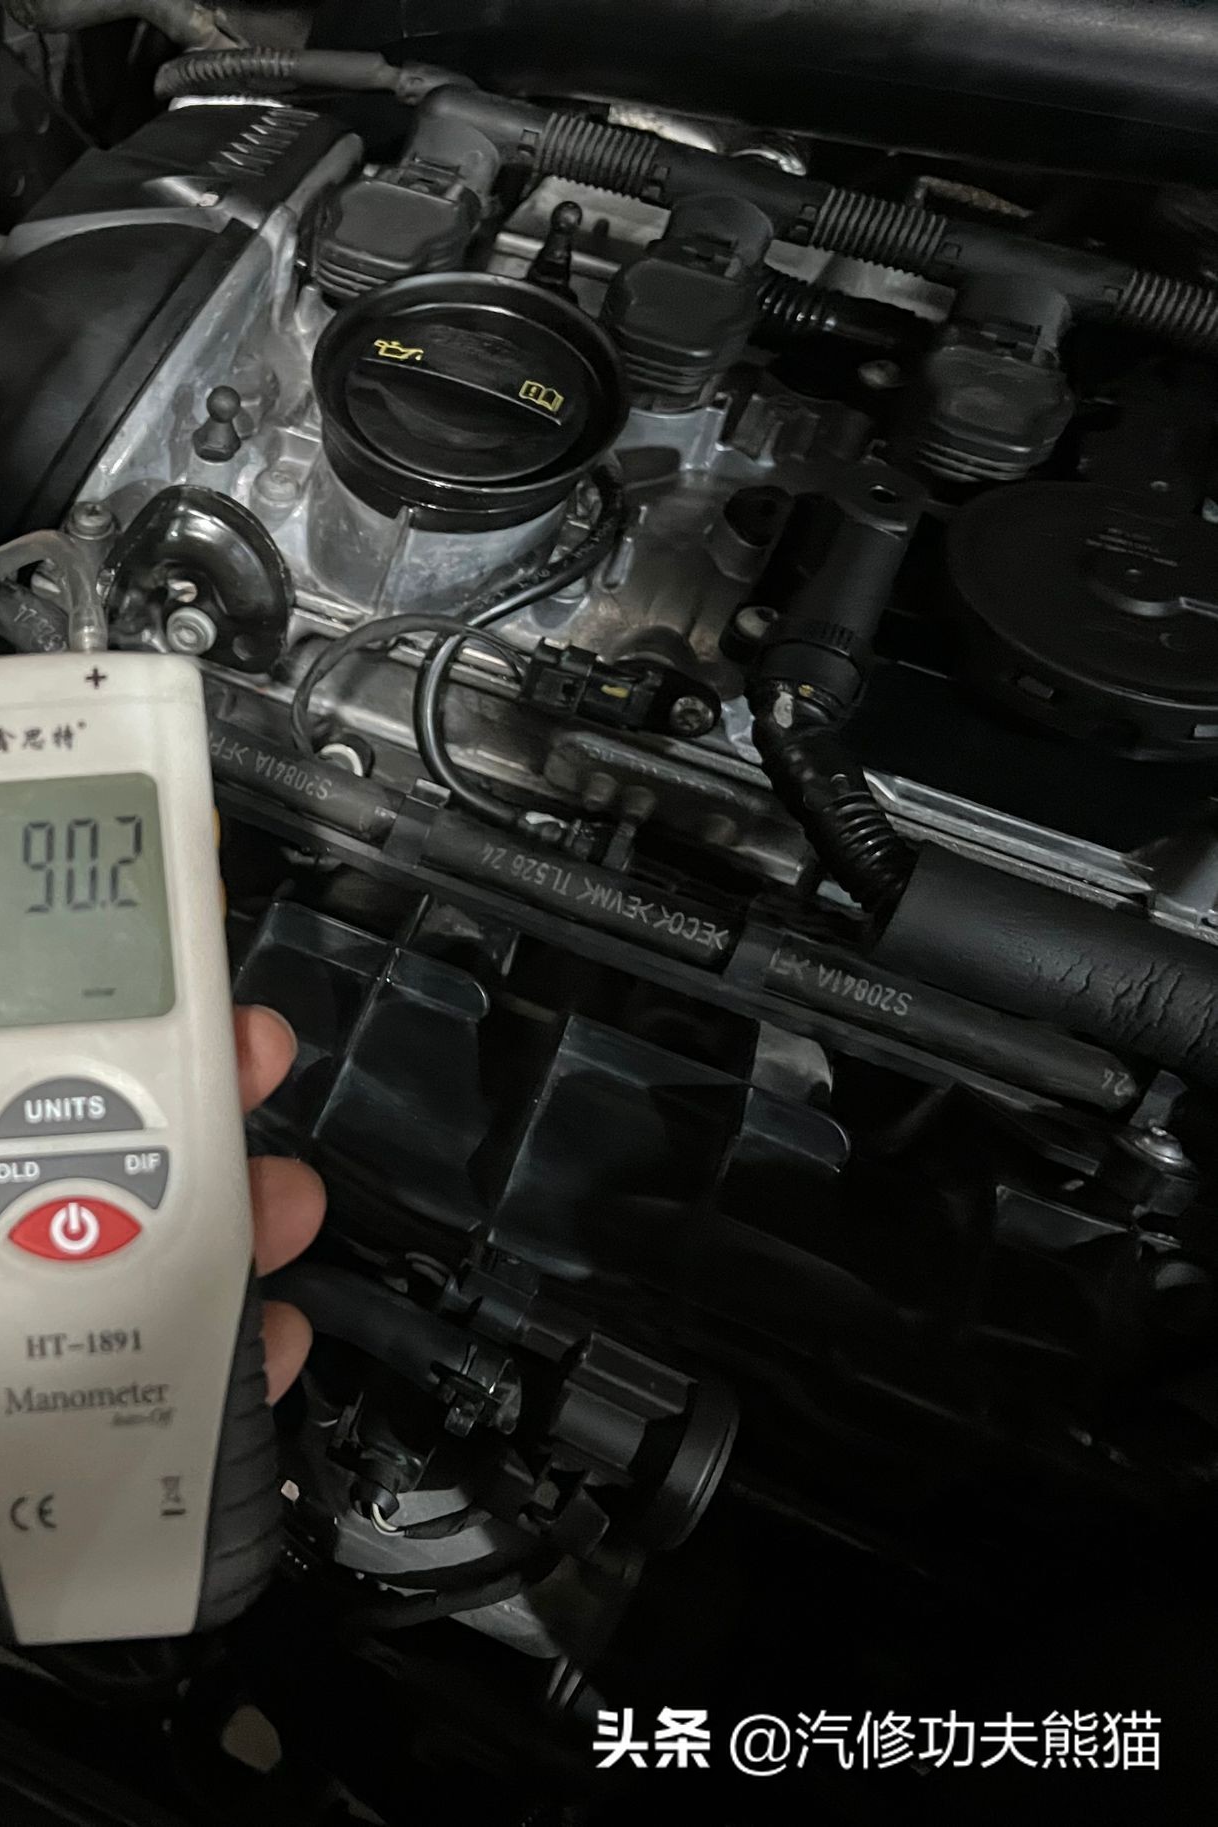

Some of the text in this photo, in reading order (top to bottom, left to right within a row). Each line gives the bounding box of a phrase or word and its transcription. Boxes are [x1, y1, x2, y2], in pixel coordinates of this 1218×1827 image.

[23, 815, 143, 914] 90.2
[819, 962, 913, 1017] S20841A
[24, 1096, 106, 1124] UNITS
[124, 1153, 162, 1175] DIF
[26, 1329, 141, 1359] HT-1891
[4, 1382, 171, 1415] Manometer
